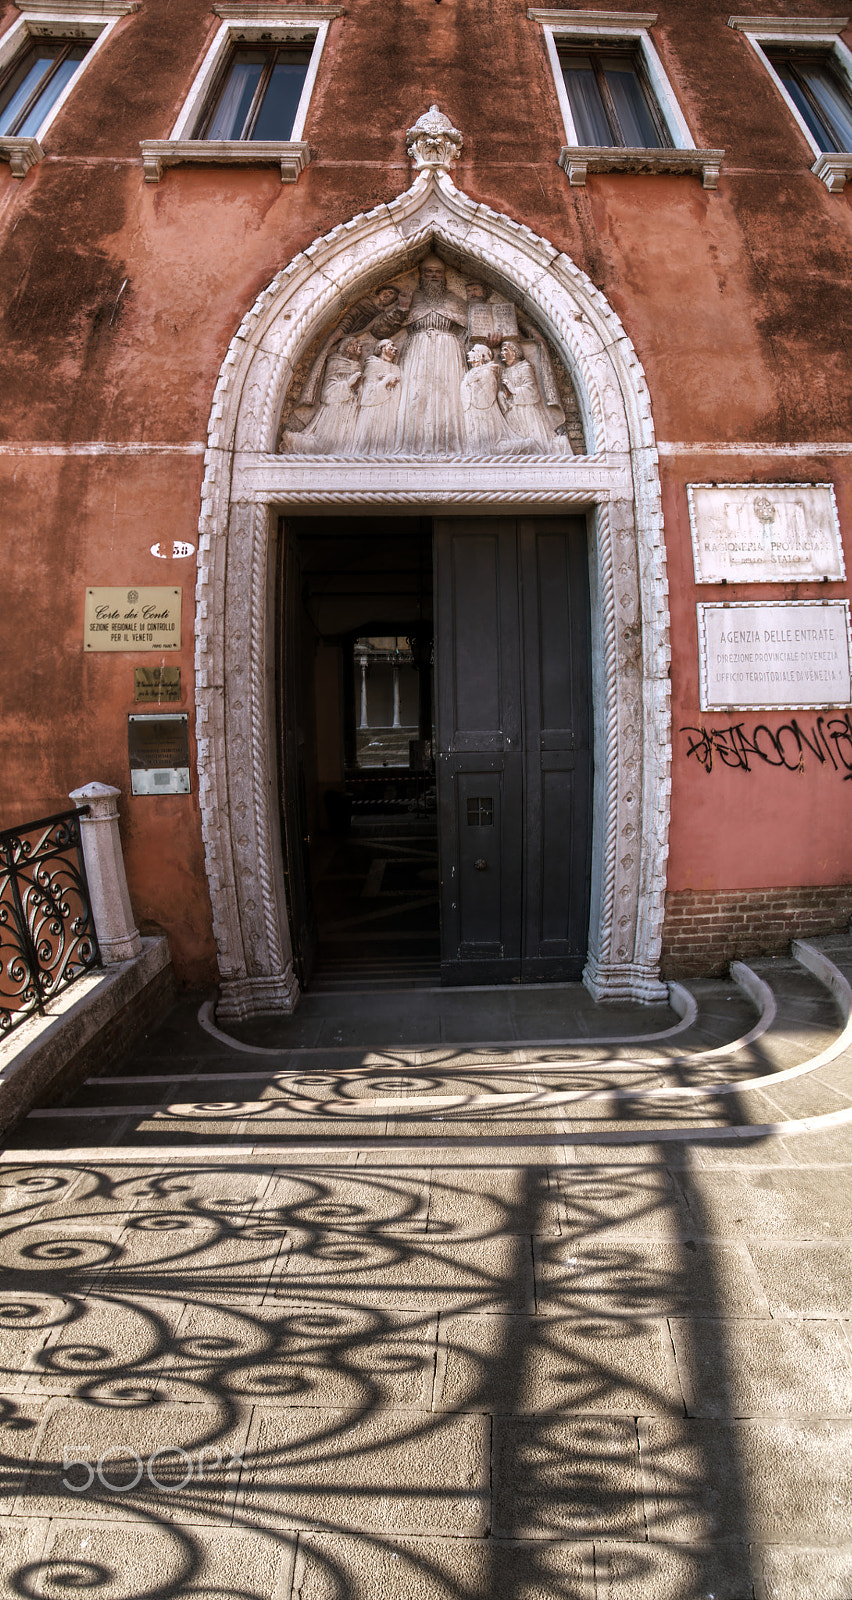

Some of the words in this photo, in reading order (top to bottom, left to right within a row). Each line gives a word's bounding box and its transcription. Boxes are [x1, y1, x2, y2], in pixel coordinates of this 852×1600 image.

[95, 605, 120, 620] Corte
[124, 608, 139, 619] dei
[142, 605, 170, 620] Conti
[89, 623, 109, 631] SEZIONE
[112, 623, 137, 631] REGIONALE
[140, 623, 145, 631] DI
[147, 623, 175, 631] CONTROLLO
[111, 633, 121, 641] PER
[124, 633, 129, 641] IL
[132, 633, 153, 641] VENETO
[720, 631, 760, 643] AGENZIA
[764, 630, 791, 642] DELLE
[795, 629, 834, 641] ENTRATE
[717, 653, 753, 664] DIREZIONE
[755, 652, 799, 663] PROVINCIALE
[808, 651, 838, 661] VENEZIA
[716, 672, 743, 682] UFFICIO
[745, 671, 795, 682] TERRITORIALE
[805, 670, 836, 681] VENEZIA
